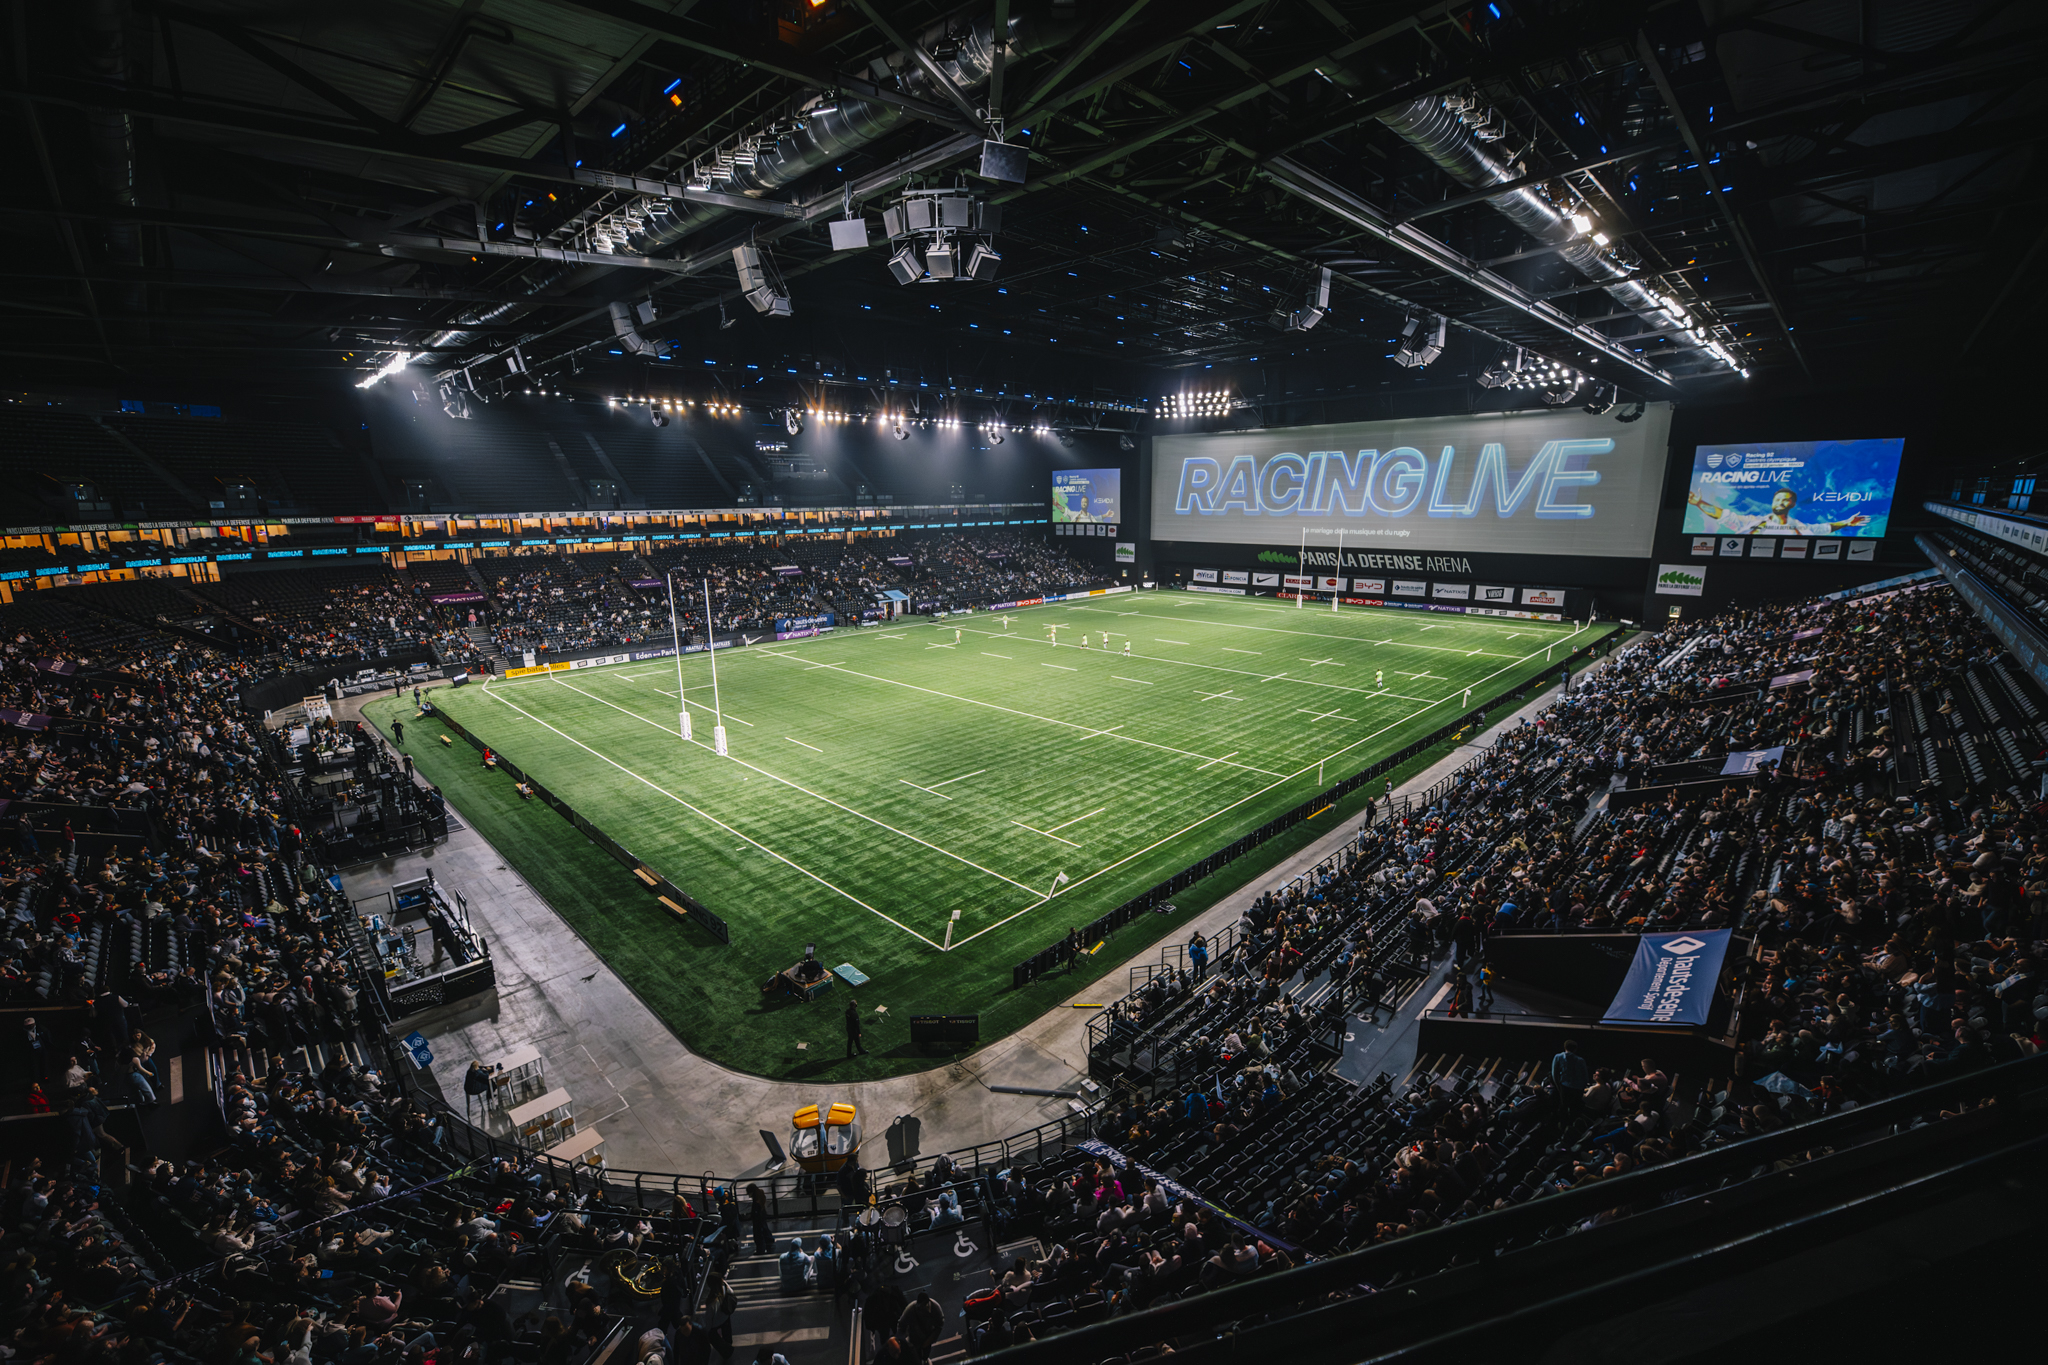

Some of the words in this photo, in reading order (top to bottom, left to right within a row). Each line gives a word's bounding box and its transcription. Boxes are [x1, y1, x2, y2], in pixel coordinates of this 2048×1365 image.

[1299, 551, 1338, 567] PARIS
[1340, 553, 1357, 568] LA
[1358, 554, 1423, 571] DEFENSE
[1426, 556, 1472, 573] ARENA
[635, 652, 652, 660] Eden
